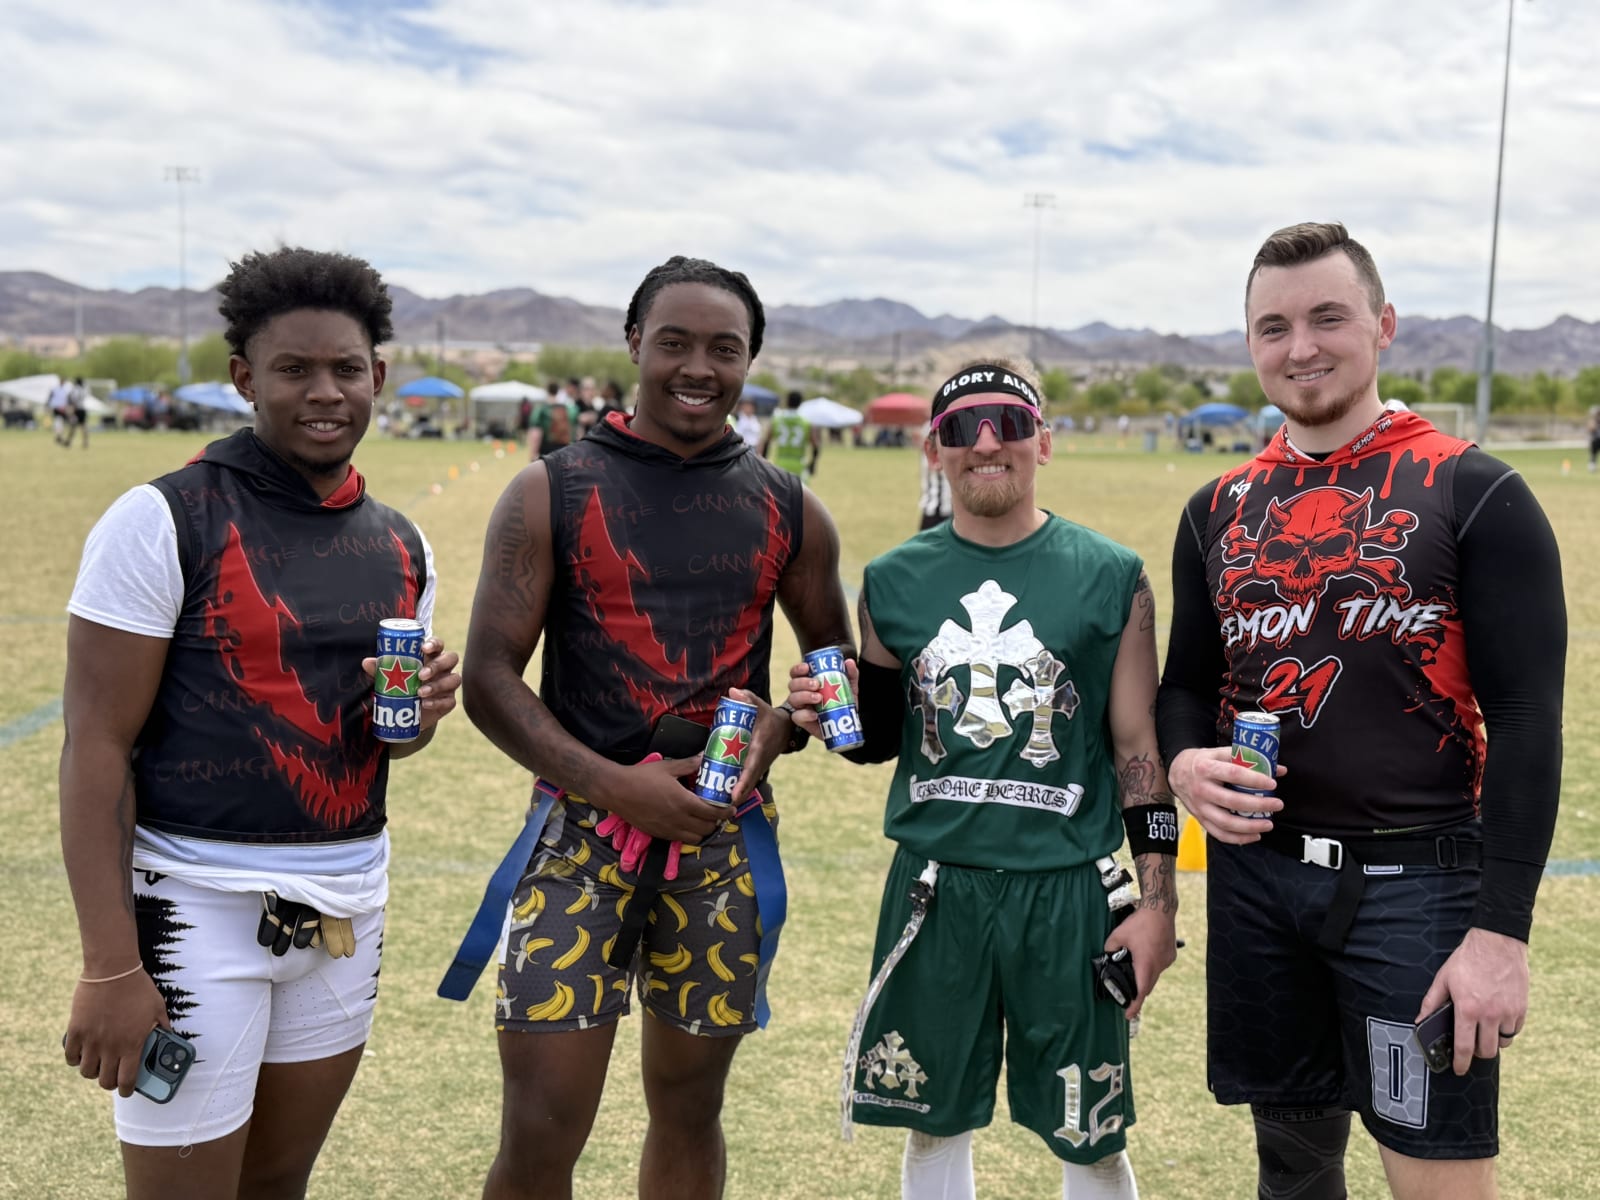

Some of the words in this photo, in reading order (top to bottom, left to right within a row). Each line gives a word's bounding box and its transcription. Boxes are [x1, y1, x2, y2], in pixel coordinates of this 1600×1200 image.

[943, 371, 995, 397] GLORY
[1351, 429, 1375, 455] DEMON
[1337, 596, 1451, 641] TIME
[1257, 655, 1343, 729] 21
[984, 781, 1068, 809] HEARTS
[1146, 811, 1152, 824] I
[1148, 823, 1177, 842] GOD
[1053, 1061, 1125, 1148] 12
